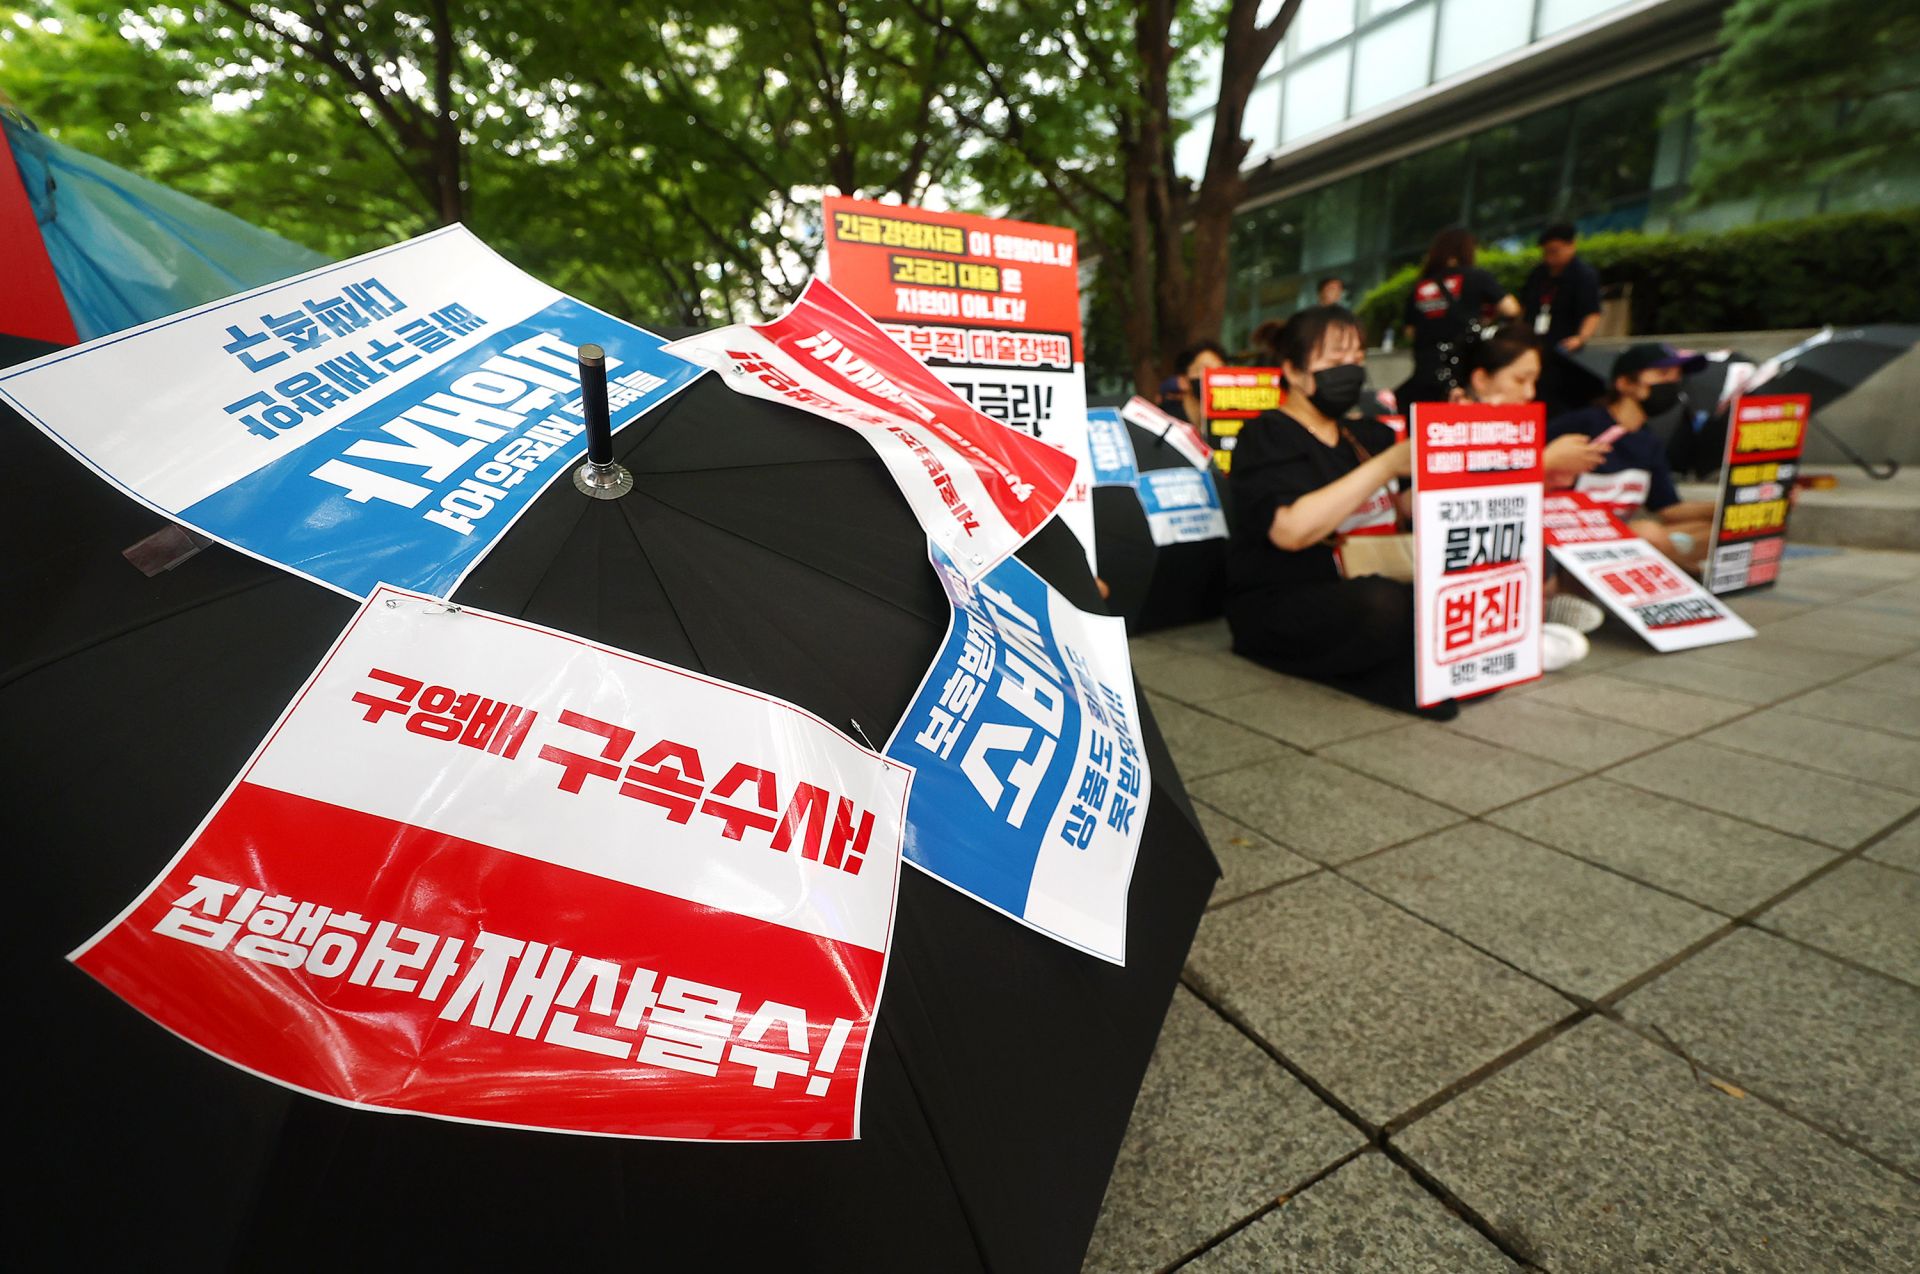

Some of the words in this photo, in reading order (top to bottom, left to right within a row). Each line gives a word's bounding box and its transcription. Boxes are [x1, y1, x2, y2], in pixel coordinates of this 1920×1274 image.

[893, 256, 956, 287] 고금리
[895, 288, 959, 318] 지원이
[221, 277, 407, 373] 대책촉구
[972, 333, 1068, 364] 대출장벽!
[309, 332, 624, 509] 피해자
[423, 413, 586, 536] 제정하여
[1445, 522, 1524, 571] 묻지마
[1445, 580, 1521, 652] 범죄!
[959, 581, 1065, 829] 소비자
[351, 668, 537, 760] 구영배
[537, 709, 876, 875] 구속수사!
[1060, 730, 1113, 851] 상품도
